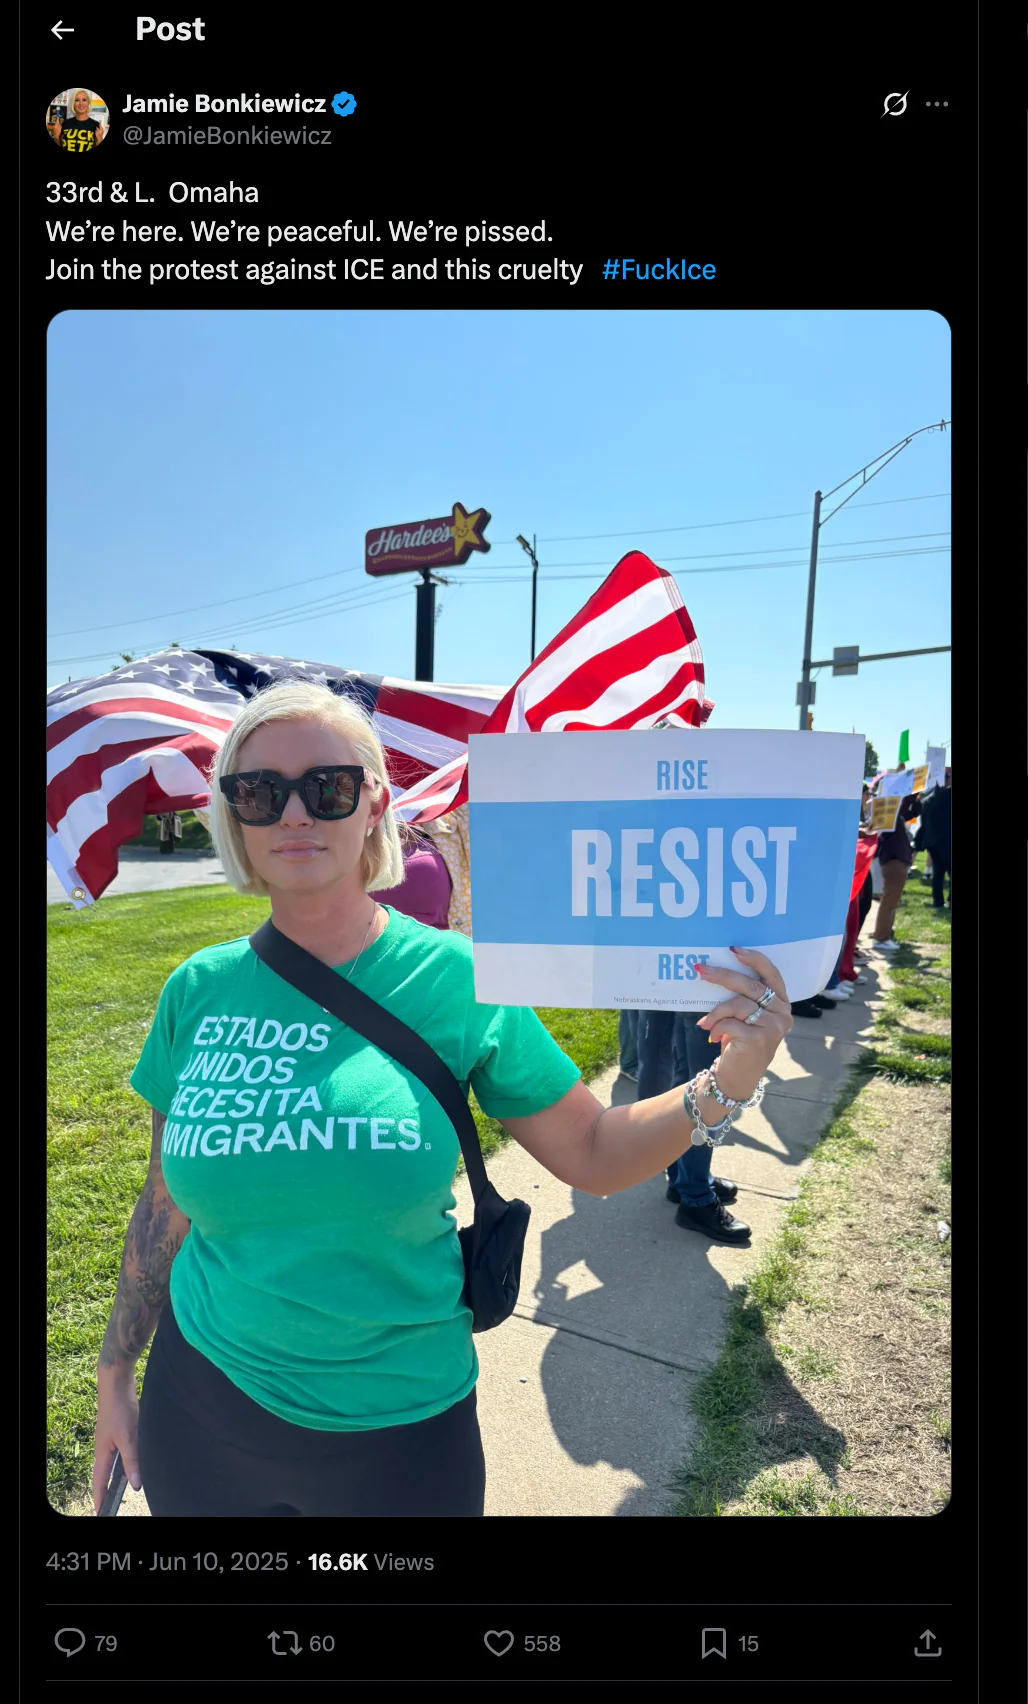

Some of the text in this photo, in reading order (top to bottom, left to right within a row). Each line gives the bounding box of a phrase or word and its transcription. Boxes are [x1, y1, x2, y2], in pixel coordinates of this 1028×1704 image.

[137, 17, 205, 41] Post
[122, 93, 326, 113] Jamie Bonkiewicz
[123, 125, 331, 146] @JamieBonkiewicz
[46, 181, 258, 203] 33rd & L. Omaha
[46, 220, 552, 247] We’re here. We’re peaceful. We’re pissed.
[45, 258, 716, 285] Join the protest against ICE and this cruelty #FuckIce
[367, 523, 455, 556] Hardee's
[657, 760, 708, 791] RISE
[571, 826, 797, 918] RESIST
[613, 996, 652, 1004] Nebraskans
[653, 998, 678, 1006] Against
[193, 1015, 332, 1052] ESTADOS
[179, 1051, 298, 1085] UNIDOS
[46, 1552, 434, 1574] 4:31 PM Jun 10, 2025 16.6K Views
[95, 1636, 758, 1652] 79 60 558 15
